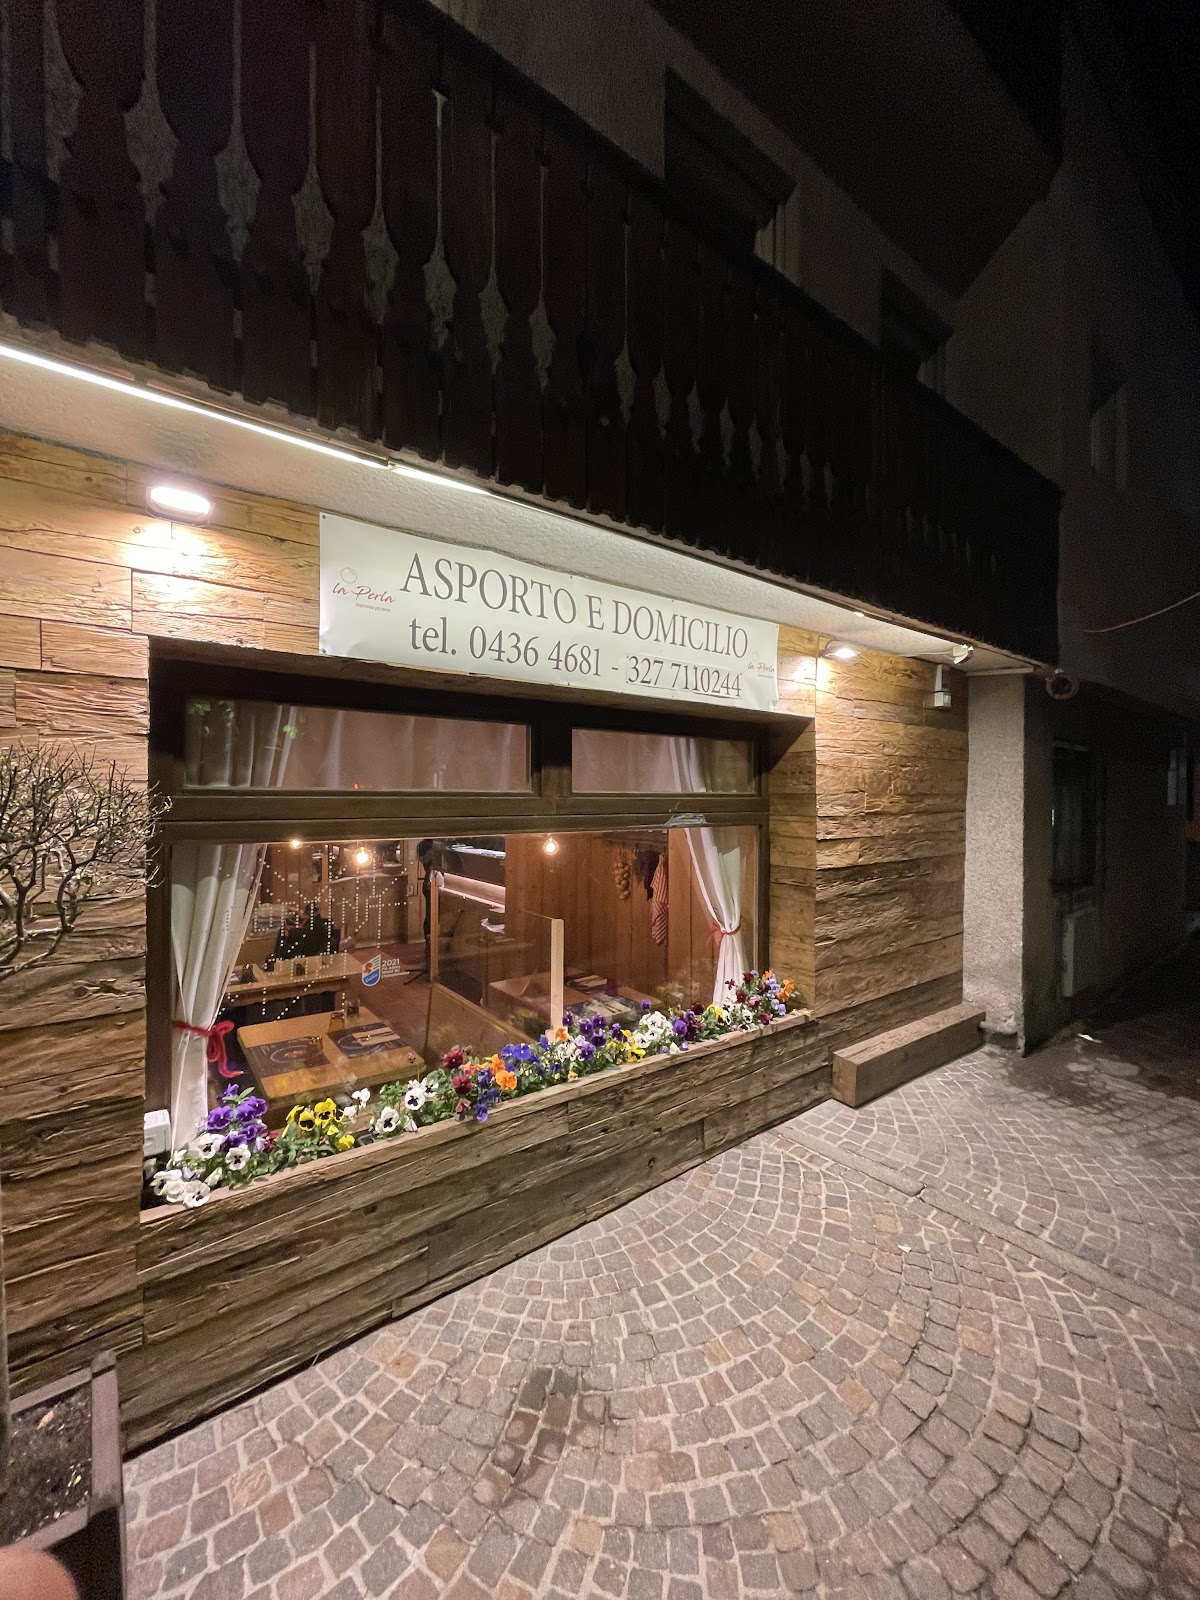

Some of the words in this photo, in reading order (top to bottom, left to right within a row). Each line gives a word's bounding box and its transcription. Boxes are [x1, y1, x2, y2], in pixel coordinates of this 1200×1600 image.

[351, 585, 395, 603] Perla
[399, 552, 577, 624] ASPORTO
[585, 594, 605, 631] E
[612, 599, 749, 659] DOMICILIO
[409, 616, 457, 656] tel.
[469, 625, 540, 667] 0436
[547, 640, 602, 677] 4681
[628, 655, 664, 686] 327
[671, 662, 742, 697] 7110244
[381, 957, 400, 967] 2021
